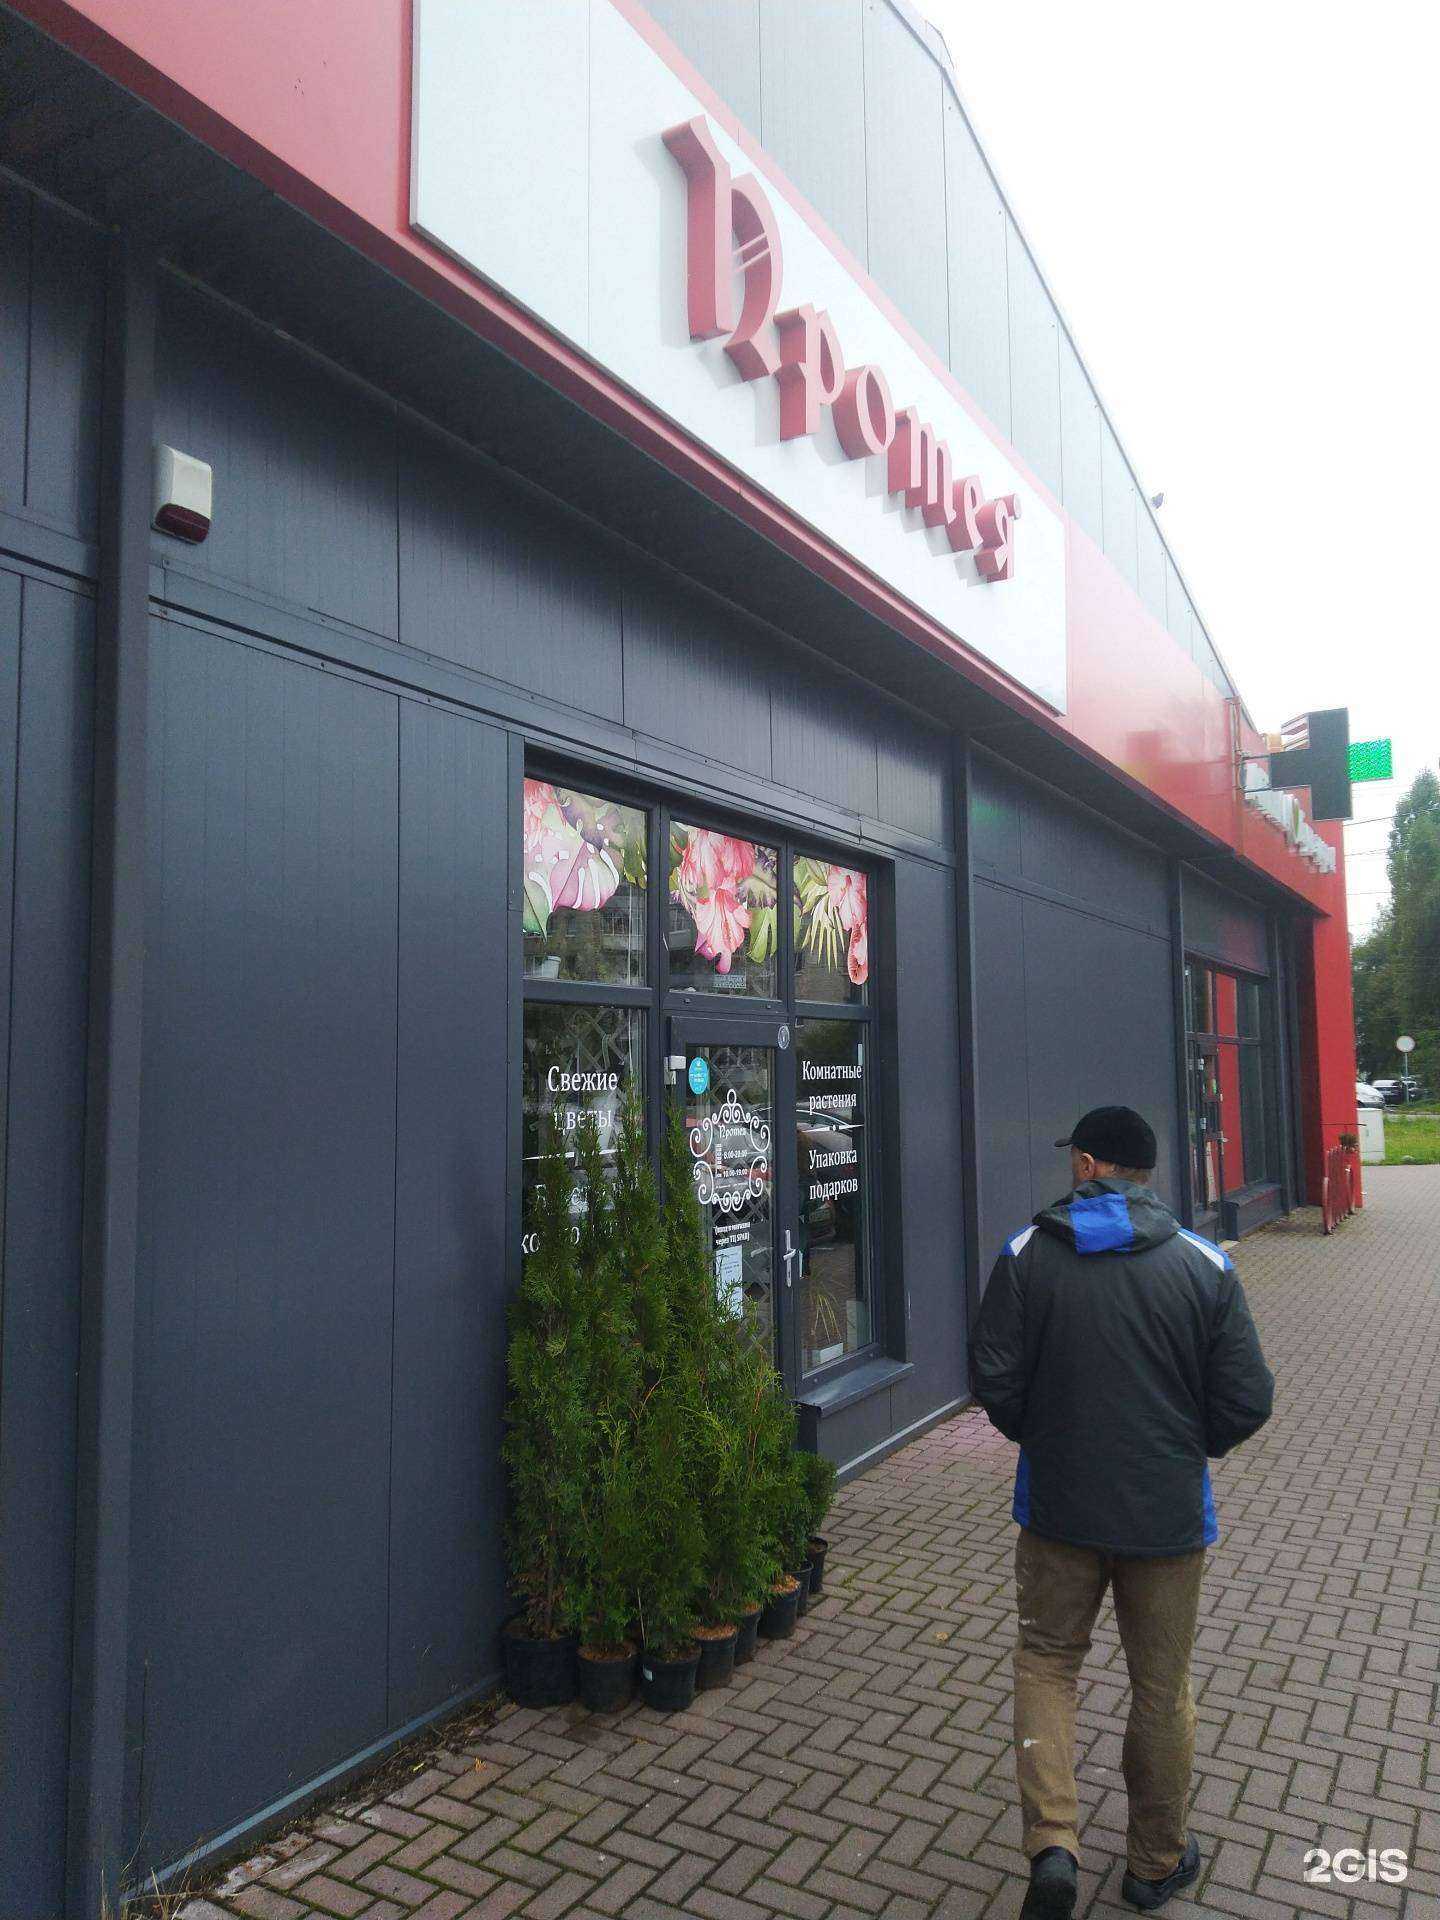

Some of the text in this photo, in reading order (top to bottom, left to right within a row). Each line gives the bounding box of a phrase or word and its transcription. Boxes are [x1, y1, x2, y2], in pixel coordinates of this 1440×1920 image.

[547, 1065, 618, 1092] Свежие
[802, 1060, 862, 1081] Комнатные
[809, 1092, 857, 1115] растения
[809, 1149, 858, 1170] Упаковка
[809, 1179, 858, 1201] подарков
